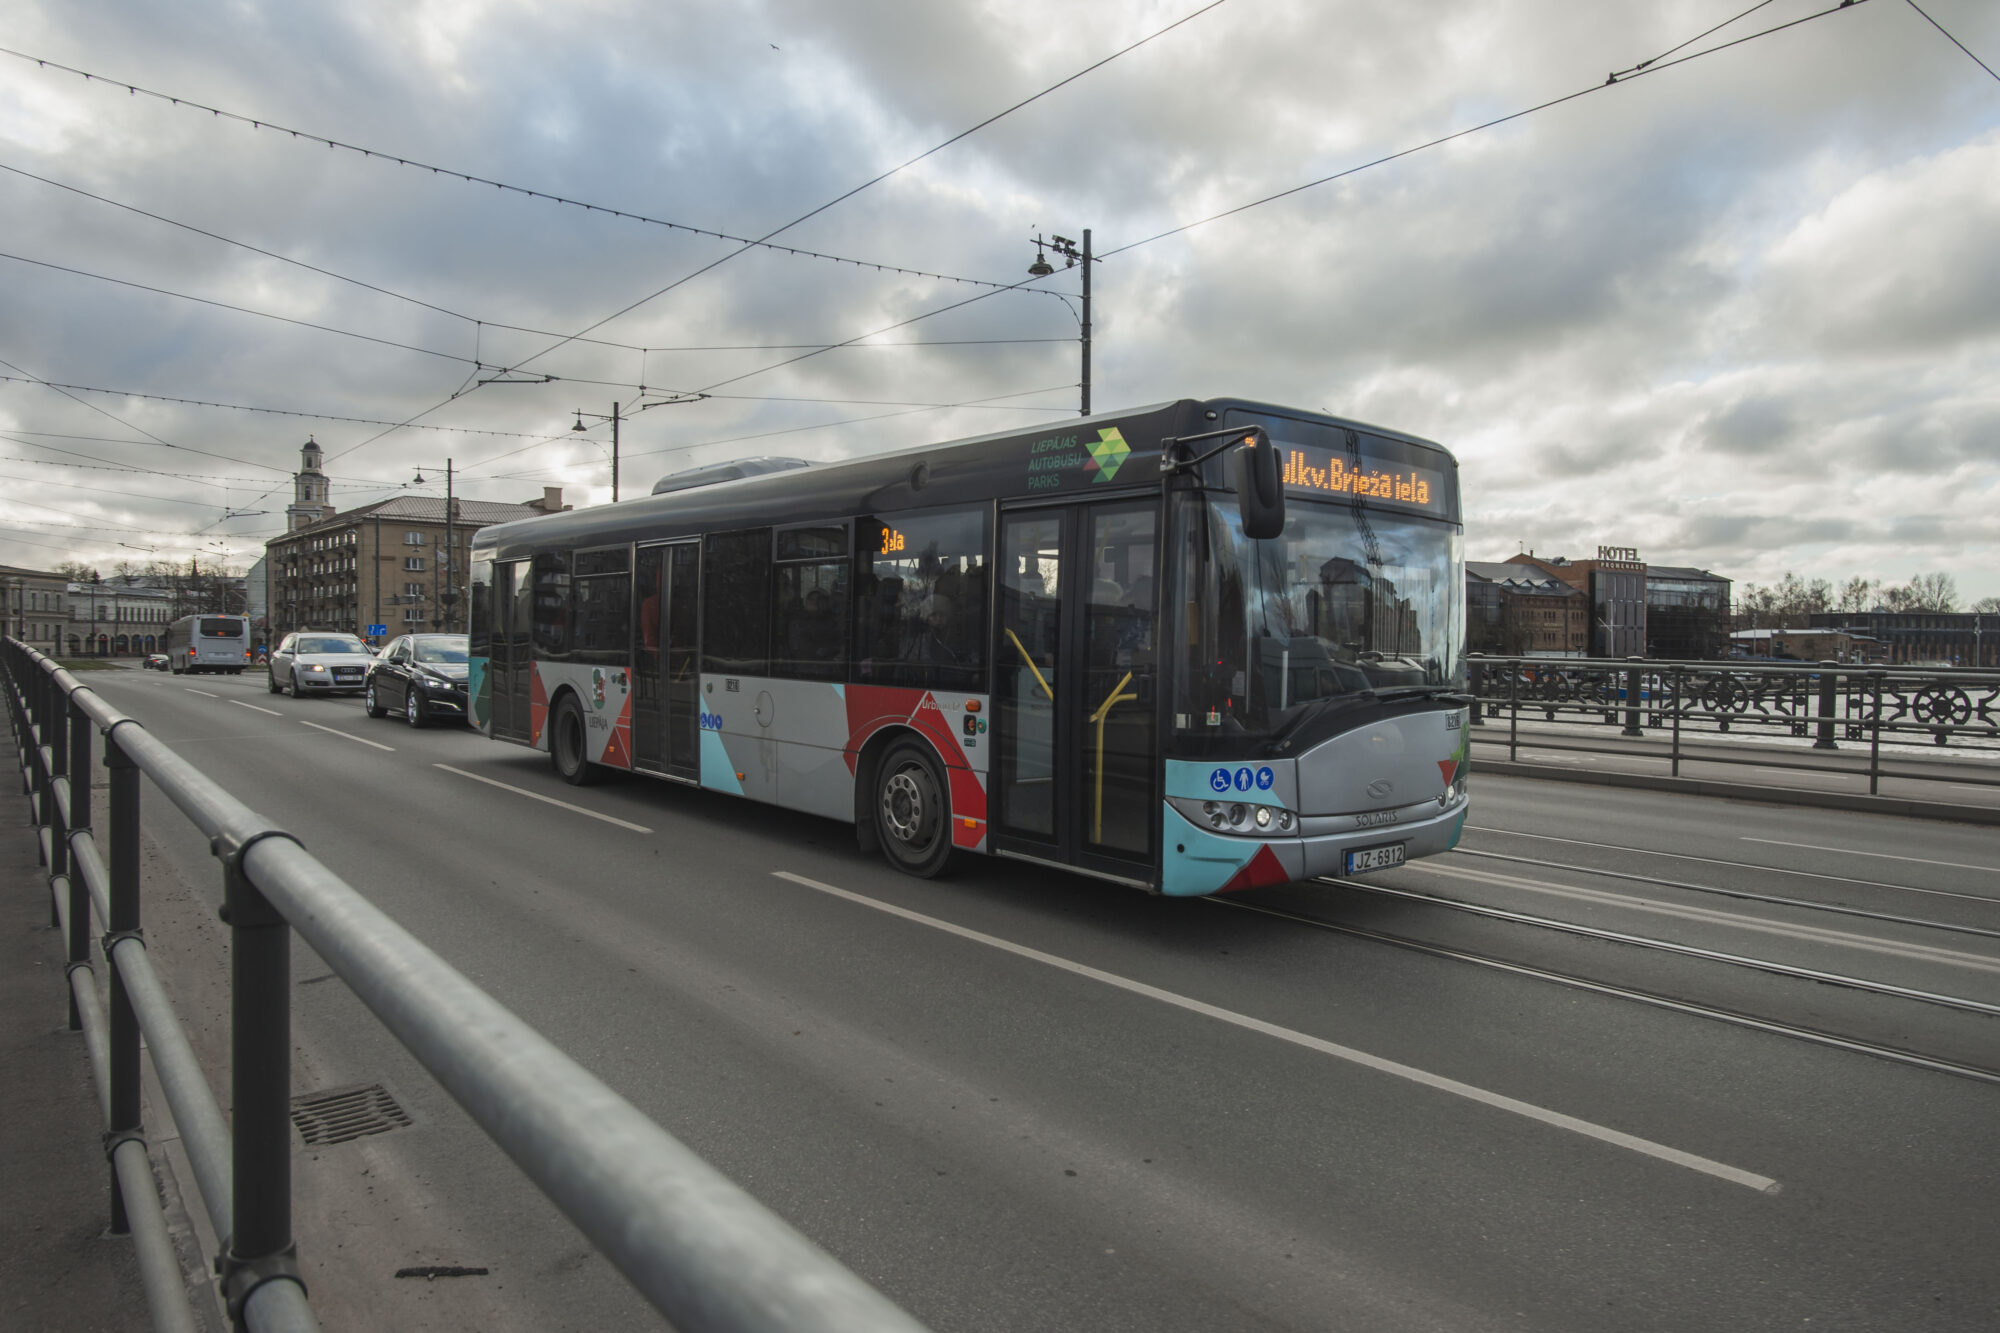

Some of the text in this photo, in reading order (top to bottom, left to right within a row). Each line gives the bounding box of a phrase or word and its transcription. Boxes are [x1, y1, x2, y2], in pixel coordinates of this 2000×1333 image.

[1031, 435, 1077, 454] LIEPĀJAS
[1028, 453, 1082, 471] AUTOBUSU
[1028, 473, 1060, 489] PARKS
[1395, 472, 1429, 504] iela
[1598, 545, 1641, 561] HOTEL
[1355, 811, 1398, 827] SOLARIS
[1356, 847, 1403, 869] JZ-6912
